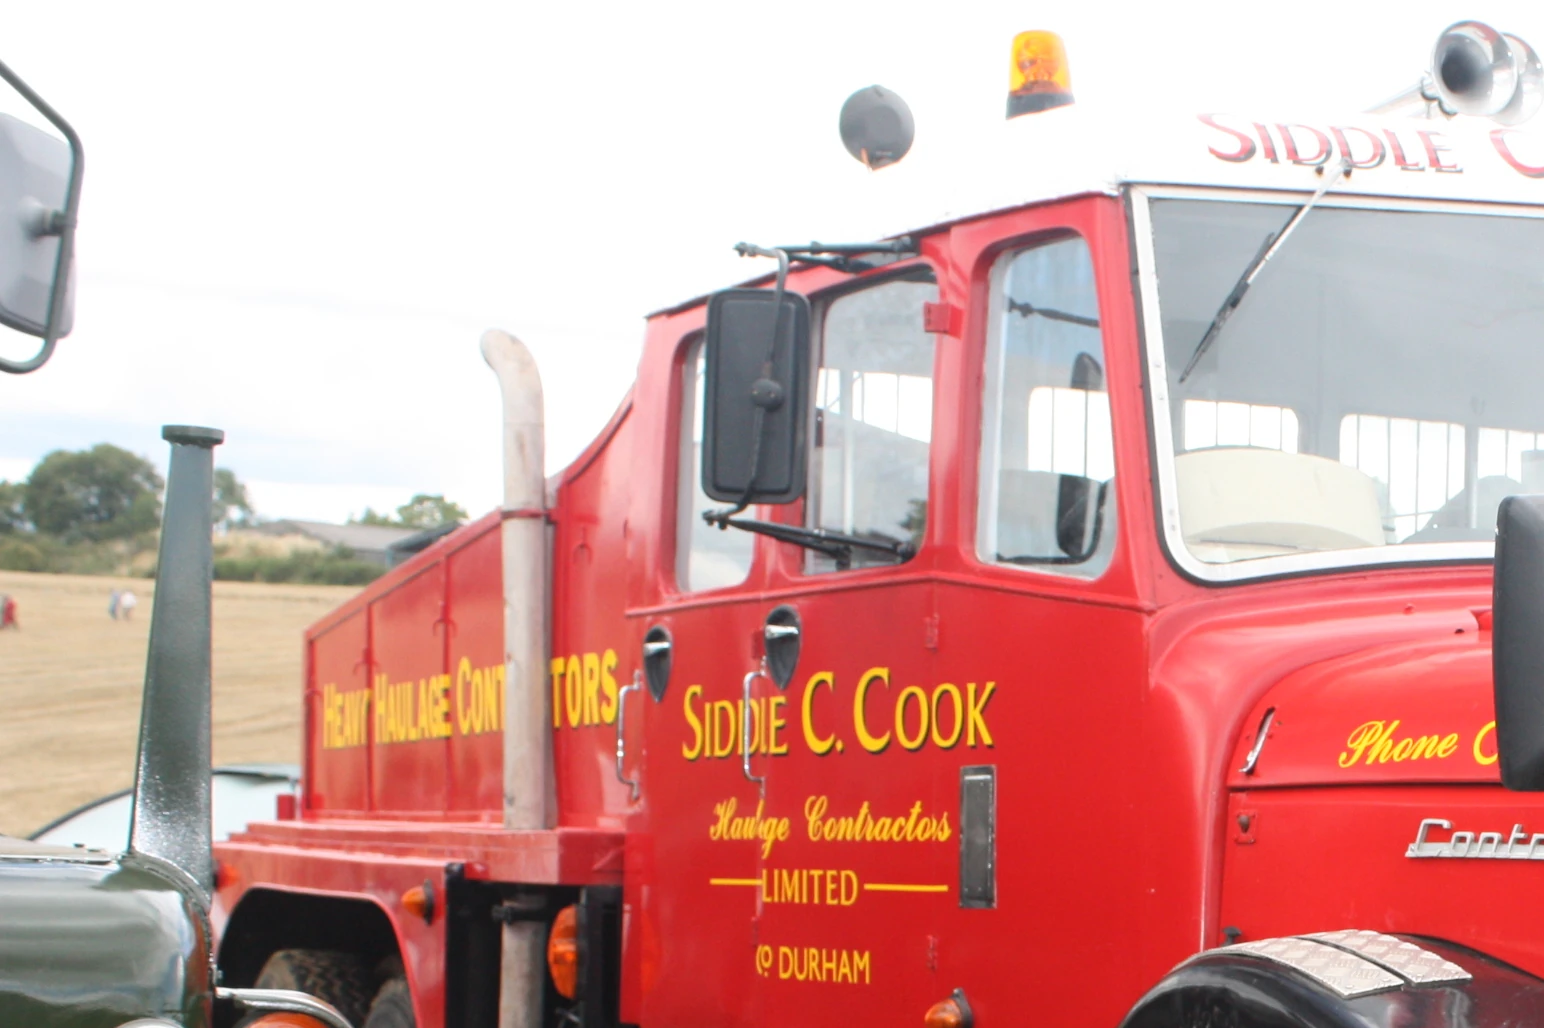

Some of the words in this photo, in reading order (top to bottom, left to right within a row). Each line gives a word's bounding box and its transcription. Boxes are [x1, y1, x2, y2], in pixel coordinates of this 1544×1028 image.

[1197, 113, 1463, 173] SIDDLE
[323, 682, 373, 749] HEAVY
[374, 673, 454, 744] HAULAGE
[456, 648, 619, 736] CONTTORS
[801, 670, 844, 755] C.
[853, 666, 996, 752] COOK
[1338, 719, 1459, 768] Phone
[804, 795, 952, 842] Contractors
[761, 868, 859, 905] LIMITED
[779, 945, 870, 985] DURHAM
